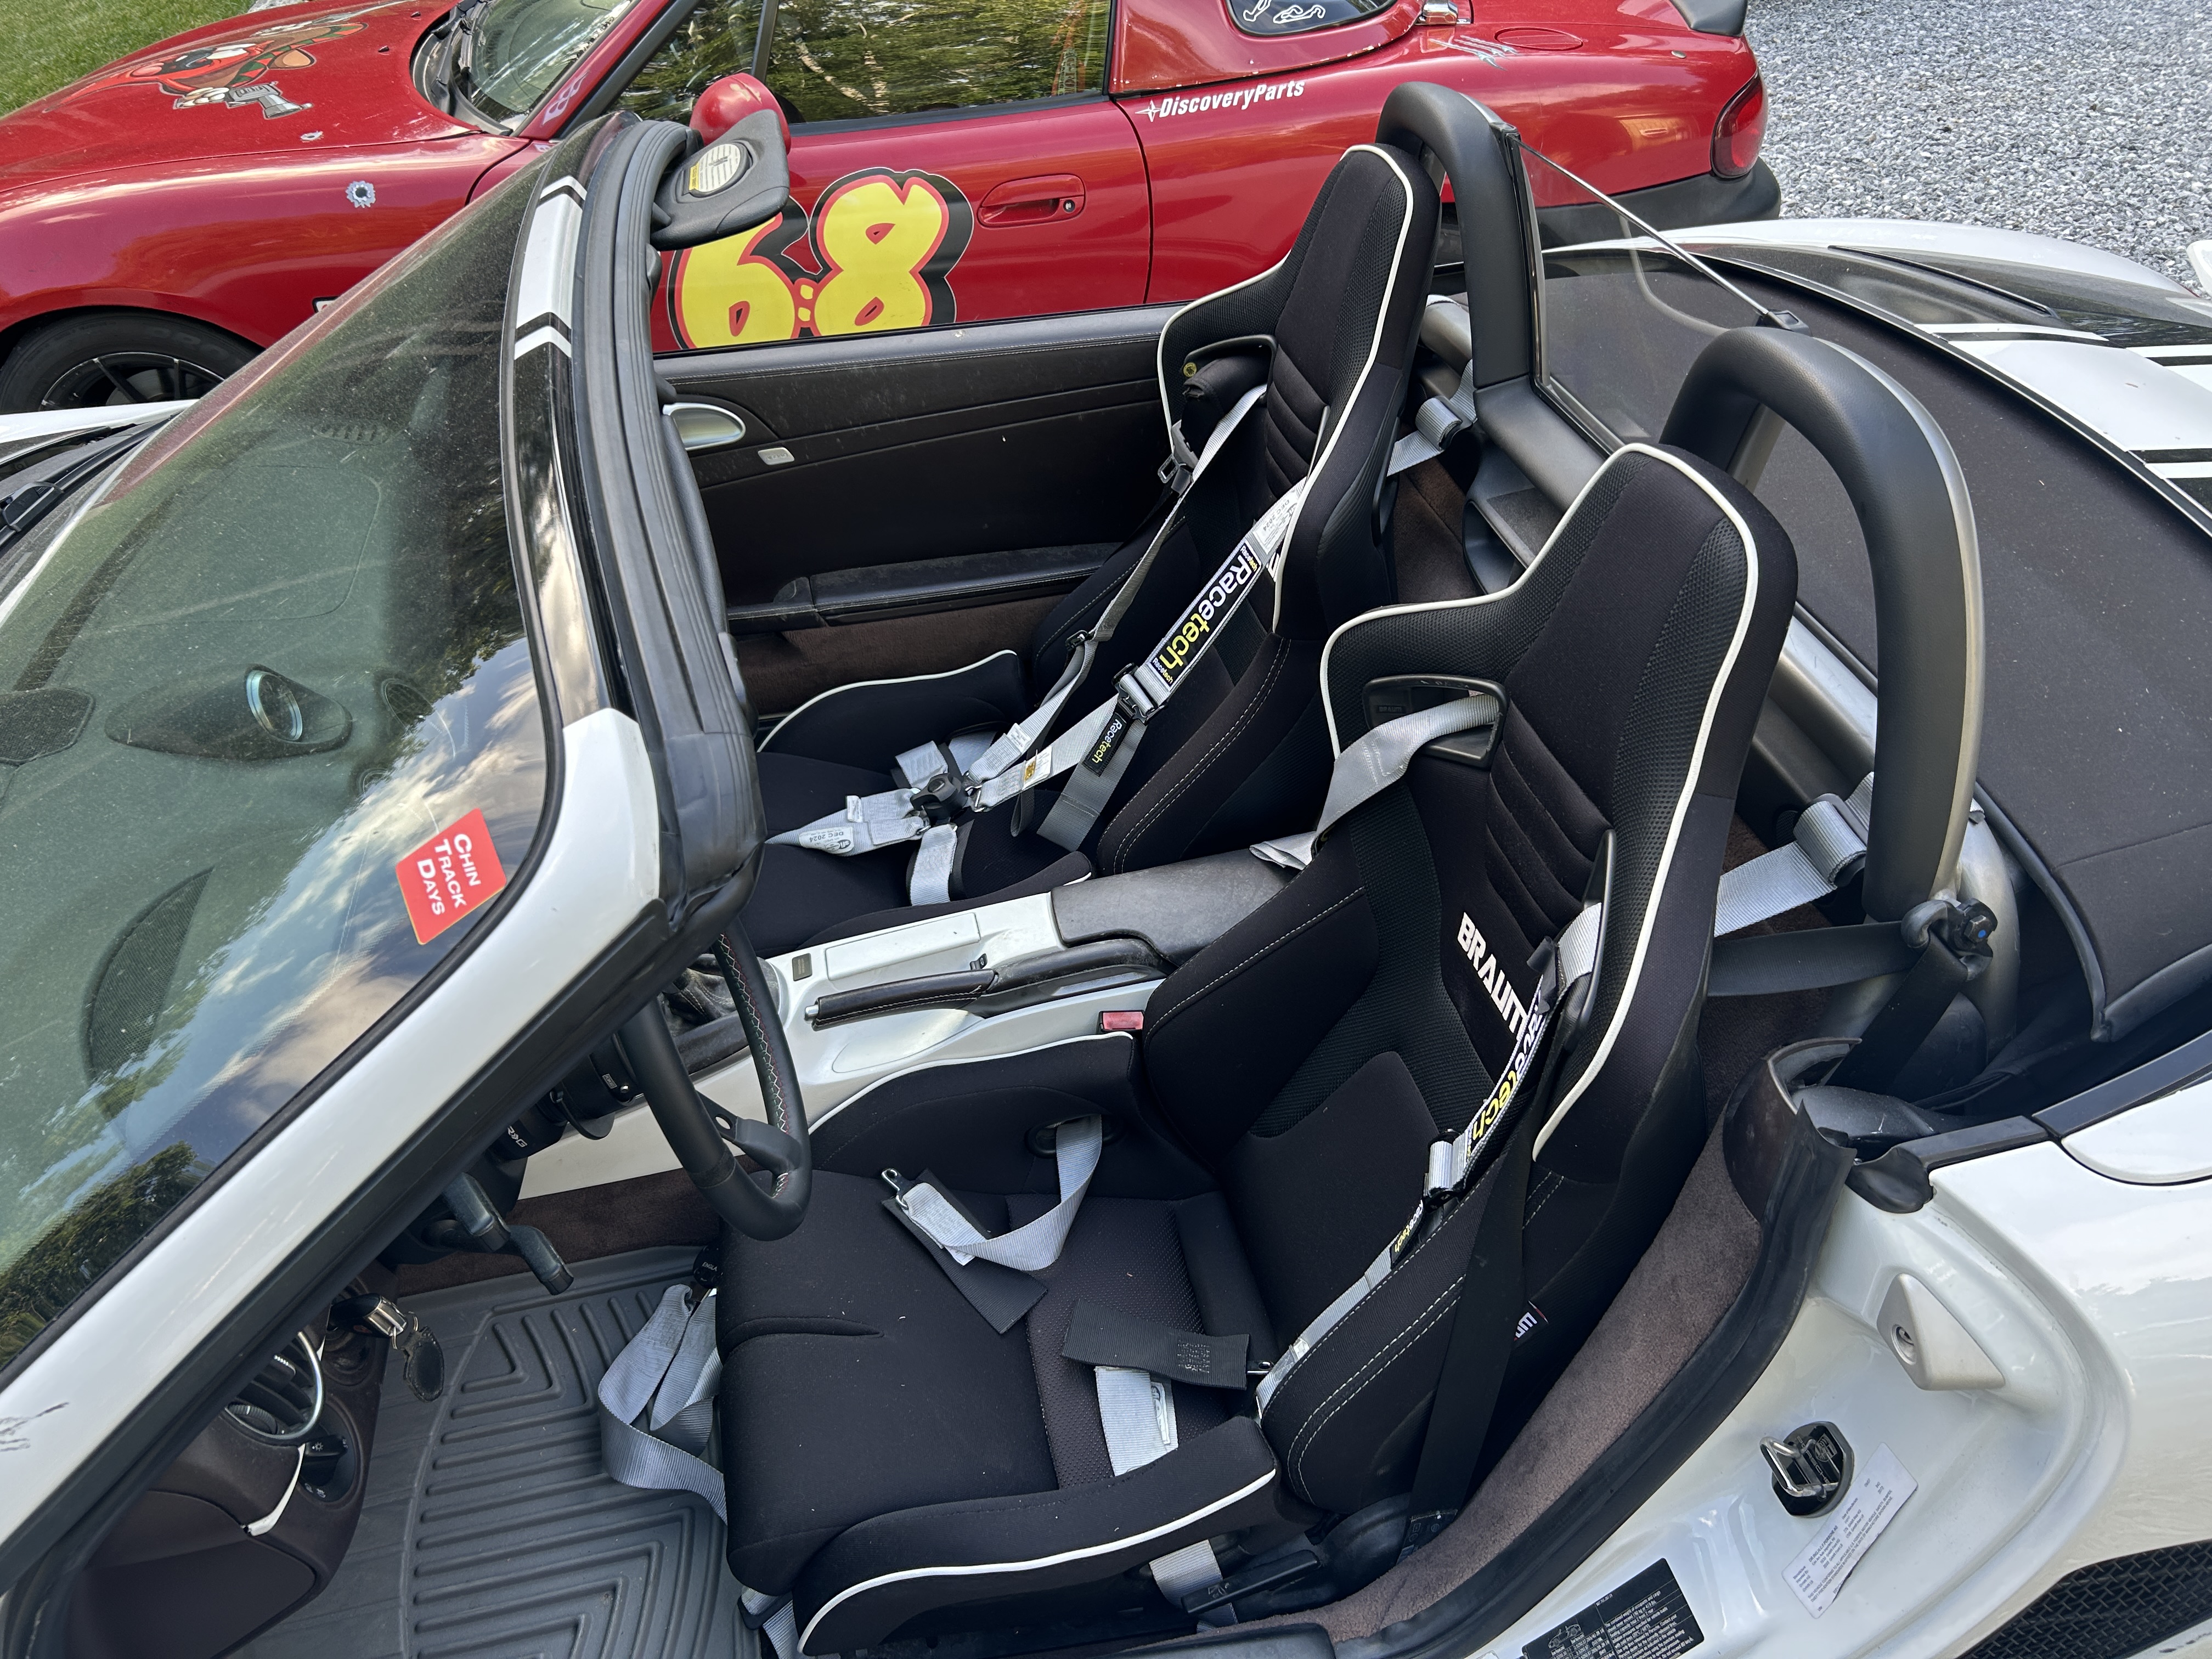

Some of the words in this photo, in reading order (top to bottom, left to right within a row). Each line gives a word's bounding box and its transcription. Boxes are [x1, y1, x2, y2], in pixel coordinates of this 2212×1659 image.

[1158, 80, 1305, 119] DiscoveryParts
[669, 169, 973, 351] 68
[1240, 545, 1258, 572] Racetech
[1159, 555, 1252, 669] Racetech
[1152, 657, 1173, 684] Racetech
[1092, 719, 1122, 764] Racetech
[454, 833, 481, 886] CHIN
[809, 834, 826, 843] 2024
[417, 859, 445, 916] DAYS
[434, 839, 467, 909] TRACK
[1458, 912, 1528, 1041] BRAUM
[1473, 1013, 1542, 1140] acetech
[701, 1261, 718, 1271] ENGLA
